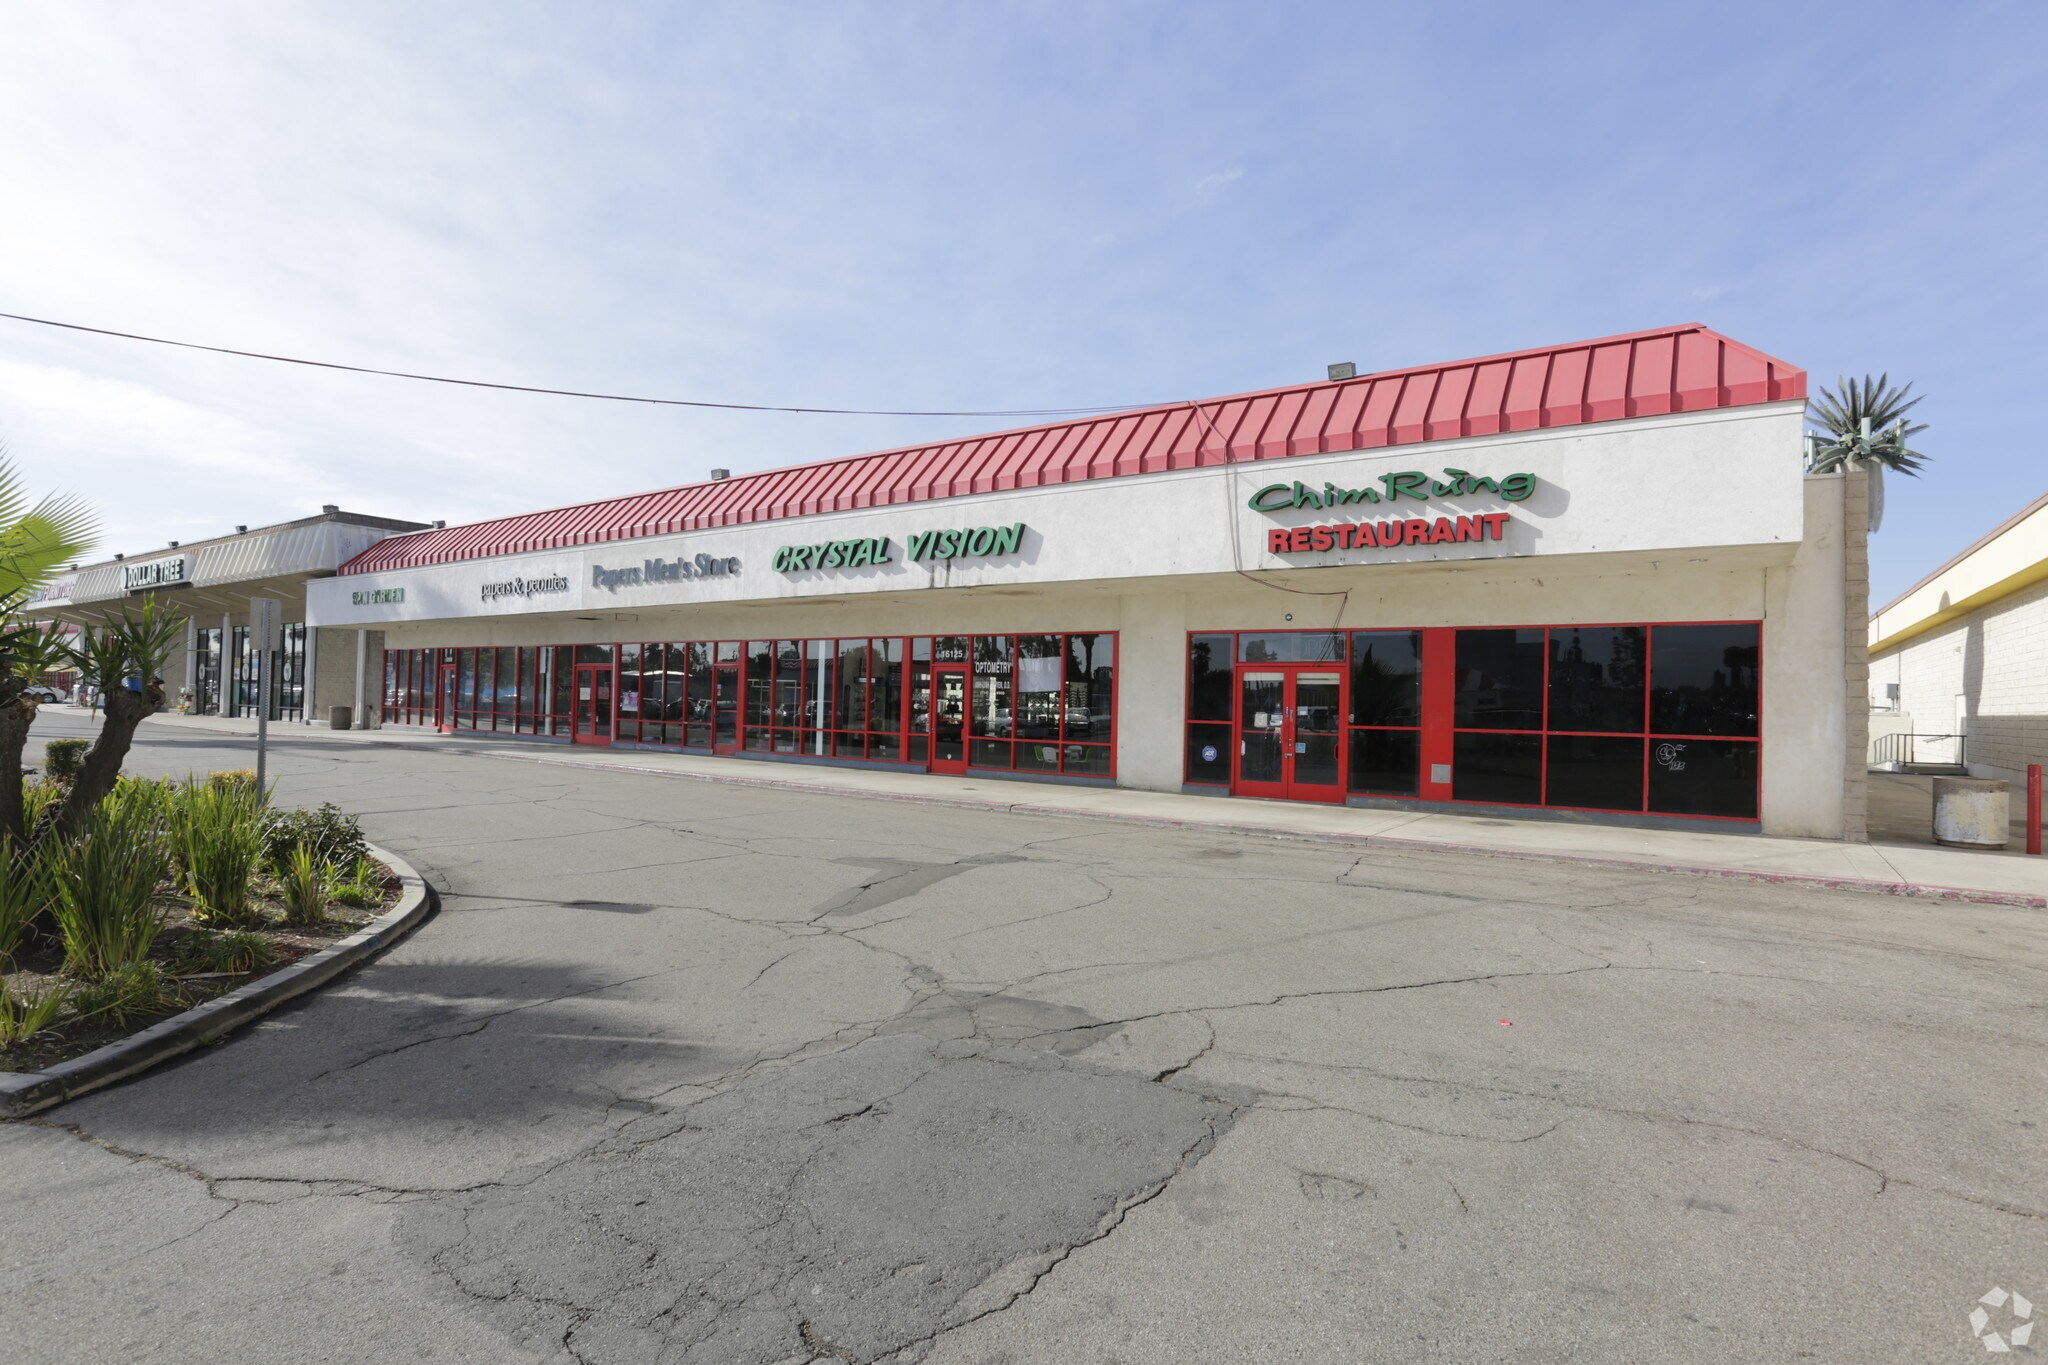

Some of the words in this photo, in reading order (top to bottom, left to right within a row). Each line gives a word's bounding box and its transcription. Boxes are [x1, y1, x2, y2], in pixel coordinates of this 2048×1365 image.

[1248, 480, 1380, 512] Chim
[771, 537, 891, 574] CRYSTAL
[906, 522, 1025, 562] VISION
[1268, 512, 1510, 554] RESTAURANT
[127, 567, 159, 588] DOLLAR
[159, 559, 184, 582] TREE
[481, 582, 513, 602] papers
[514, 577, 527, 595] &
[526, 570, 568, 597] peonies
[592, 564, 643, 593] Papers
[643, 557, 694, 585] Men's
[694, 552, 742, 579] Store
[941, 649, 963, 659] 16125
[975, 661, 1011, 673] OPTOMETRY
